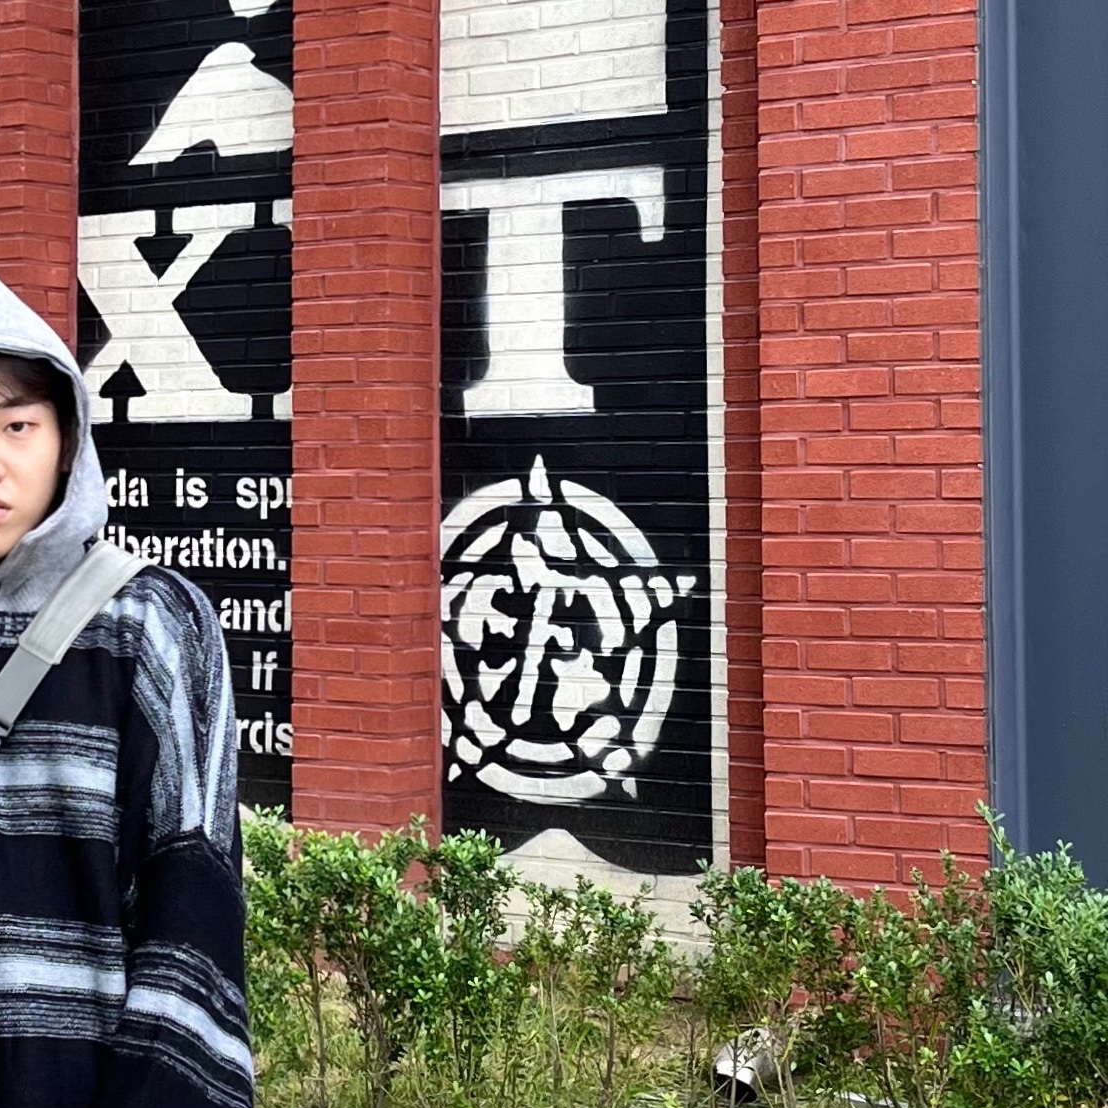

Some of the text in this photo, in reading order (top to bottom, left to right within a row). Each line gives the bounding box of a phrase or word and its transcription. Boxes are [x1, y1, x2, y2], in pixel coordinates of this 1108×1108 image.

[176, 468, 209, 509] is
[219, 590, 292, 634] and
[252, 651, 278, 691] If
